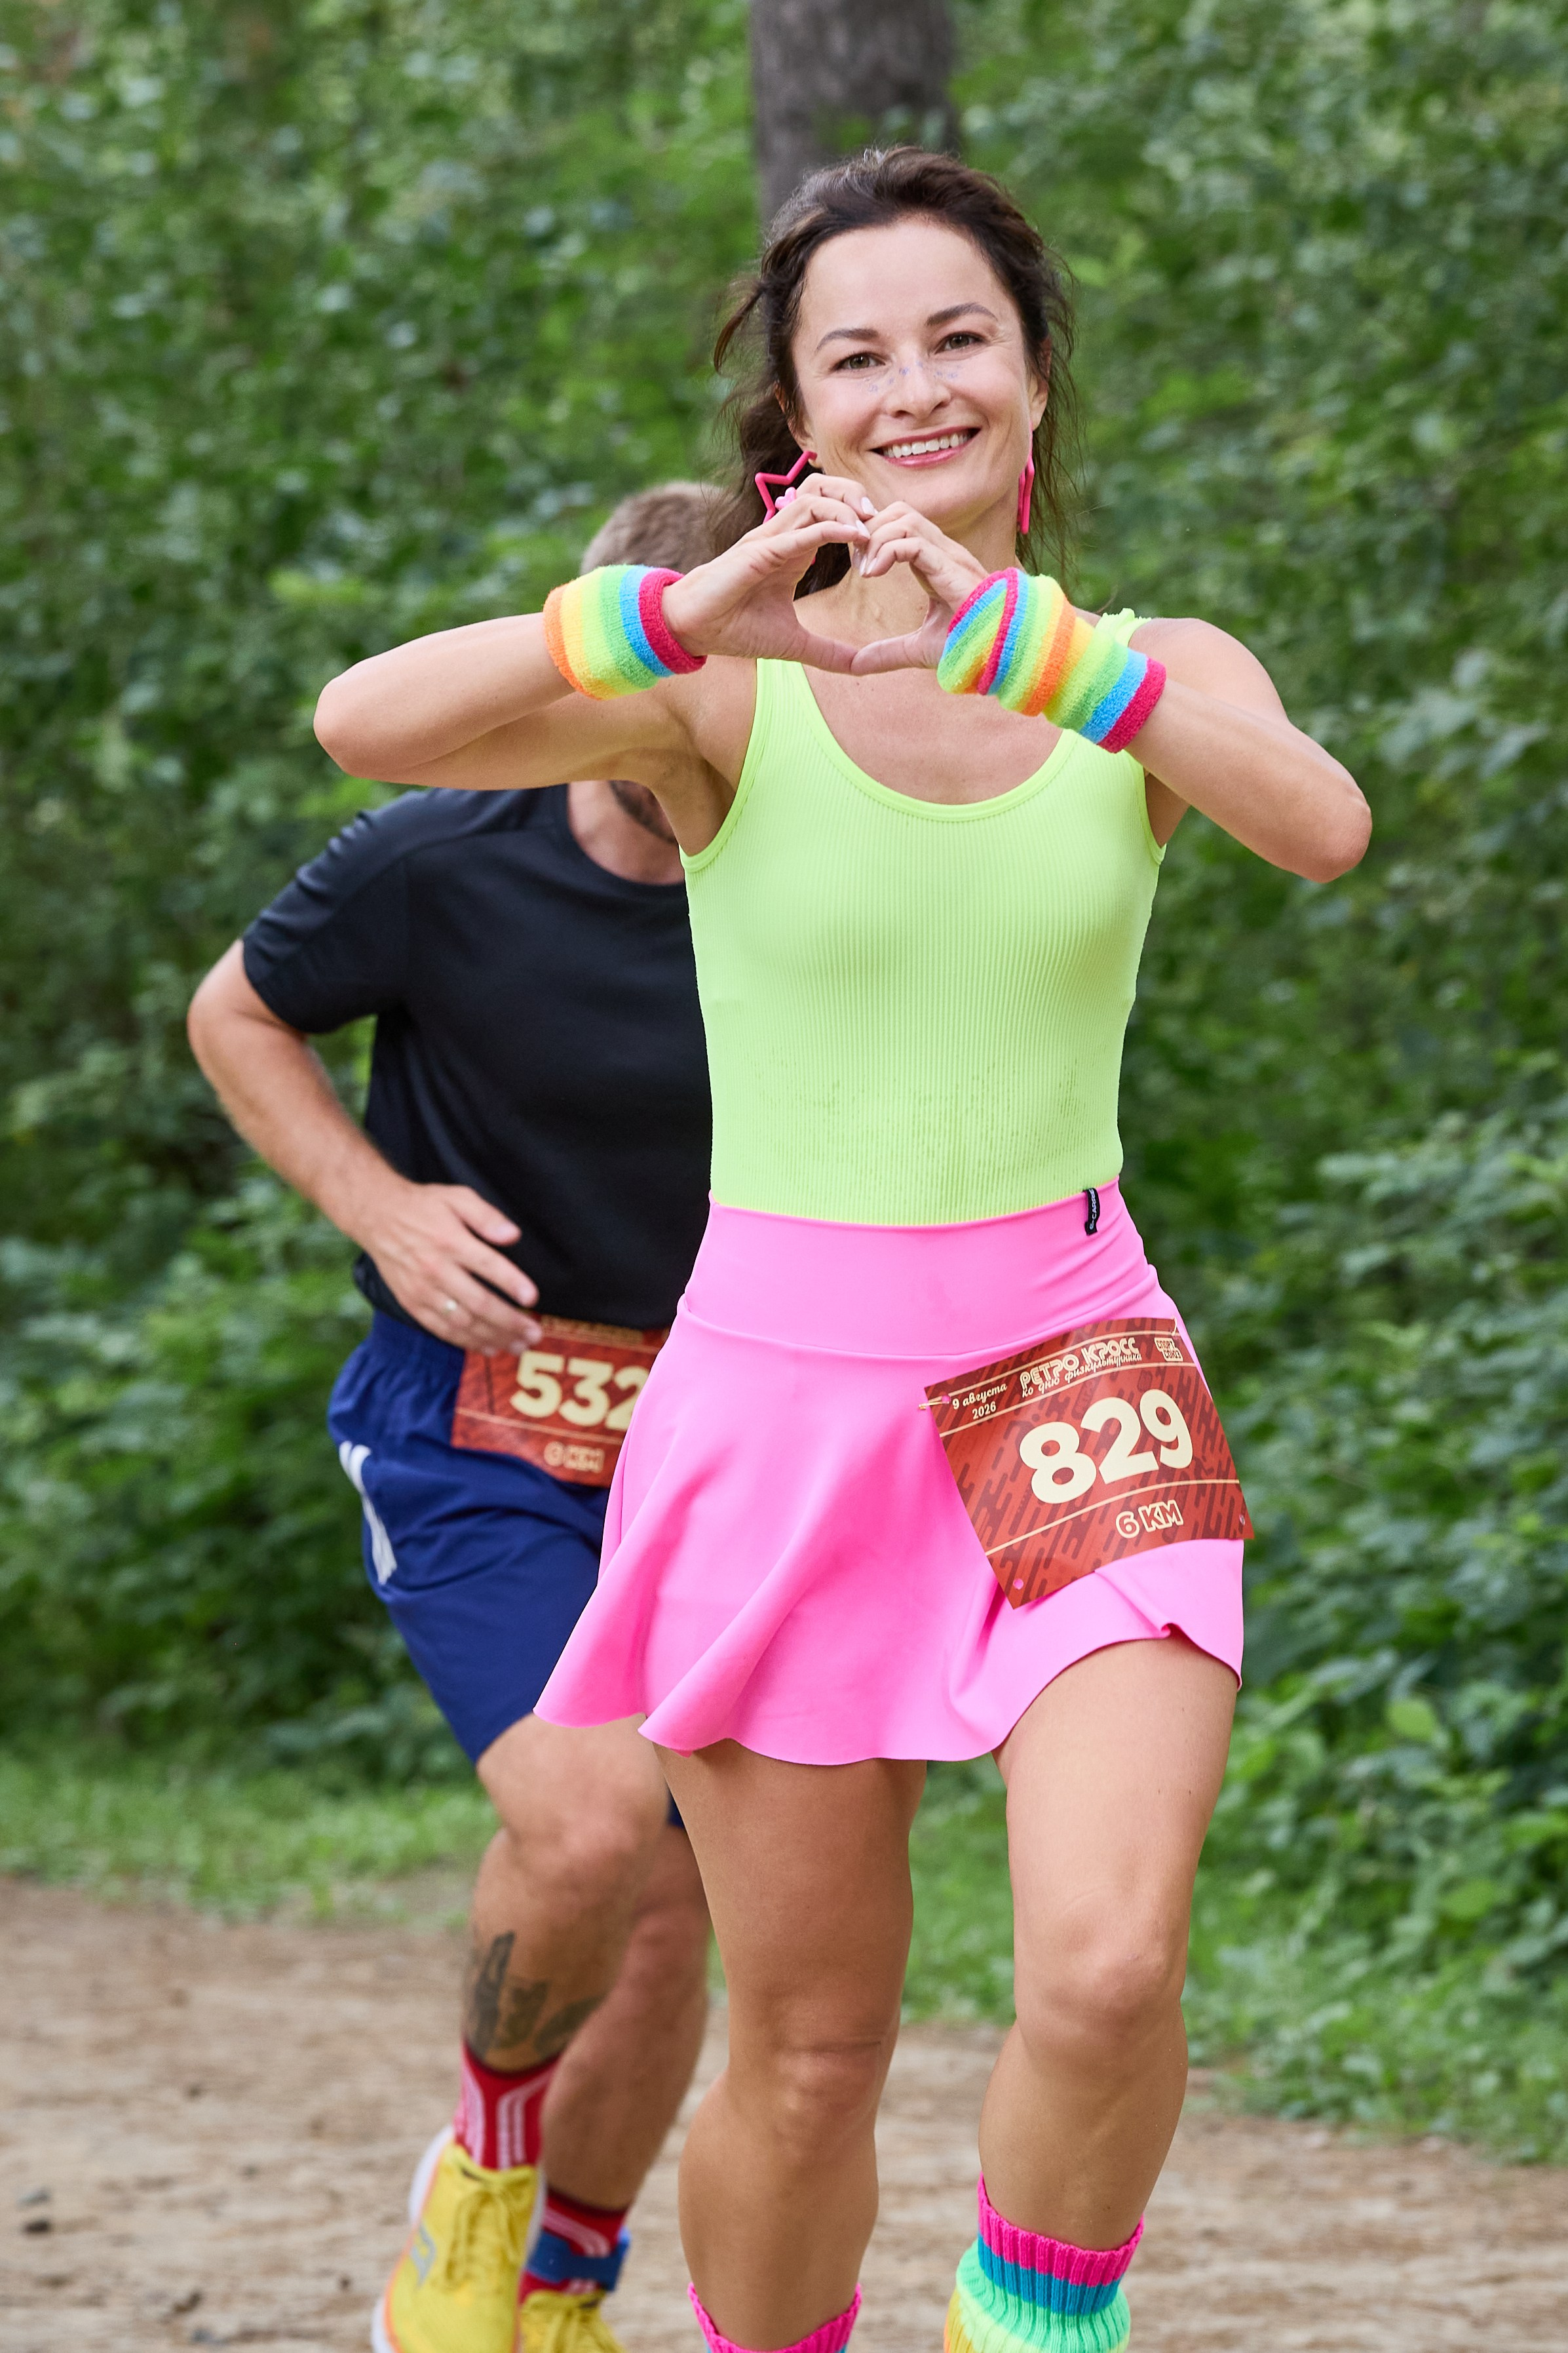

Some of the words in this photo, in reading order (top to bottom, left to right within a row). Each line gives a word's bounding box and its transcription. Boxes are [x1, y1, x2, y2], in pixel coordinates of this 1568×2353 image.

[1156, 1340, 1175, 1350] СПОРТ
[1163, 1350, 1181, 1359] СОЮЗ
[1020, 1354, 1079, 1390] РЕТРО
[1081, 1337, 1140, 1364] КРОСС
[509, 1350, 651, 1431] 532
[952, 1398, 960, 1410] 9
[962, 1383, 1008, 1407] августа
[1022, 1386, 1034, 1398] ко
[972, 1401, 997, 1420] 2026
[1019, 1388, 1194, 1504] 829
[1115, 1511, 1140, 1539] 6
[1138, 1499, 1184, 1532] КМ
